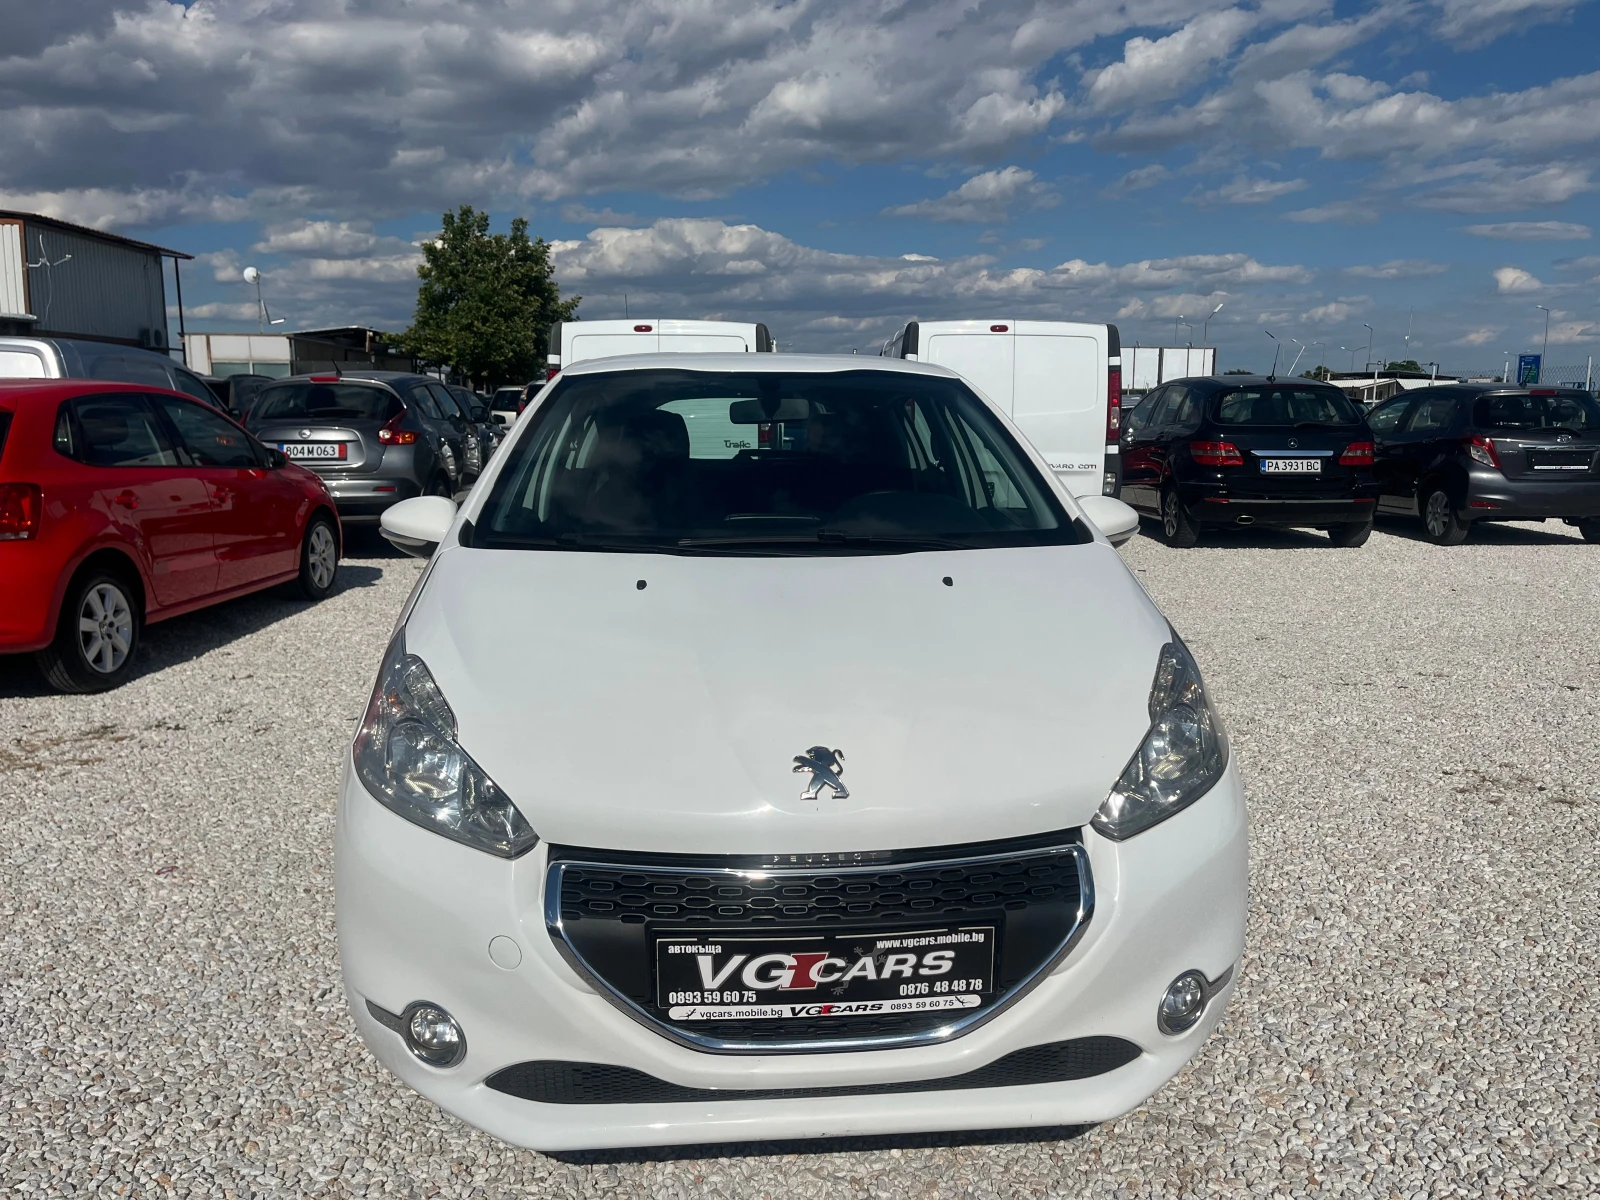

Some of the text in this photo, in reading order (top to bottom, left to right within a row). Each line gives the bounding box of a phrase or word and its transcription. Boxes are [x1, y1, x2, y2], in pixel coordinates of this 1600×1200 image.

[723, 440, 751, 448] Trafic
[876, 932, 985, 949] www.vgcars.mobile.bg
[668, 945, 722, 954] автокъща
[900, 978, 983, 996] 0876 48 48 78
[668, 990, 757, 1004] 0893 59 60 75
[700, 1008, 783, 1020] vgcars.mobile.bg
[890, 1002, 913, 1010] 0893
